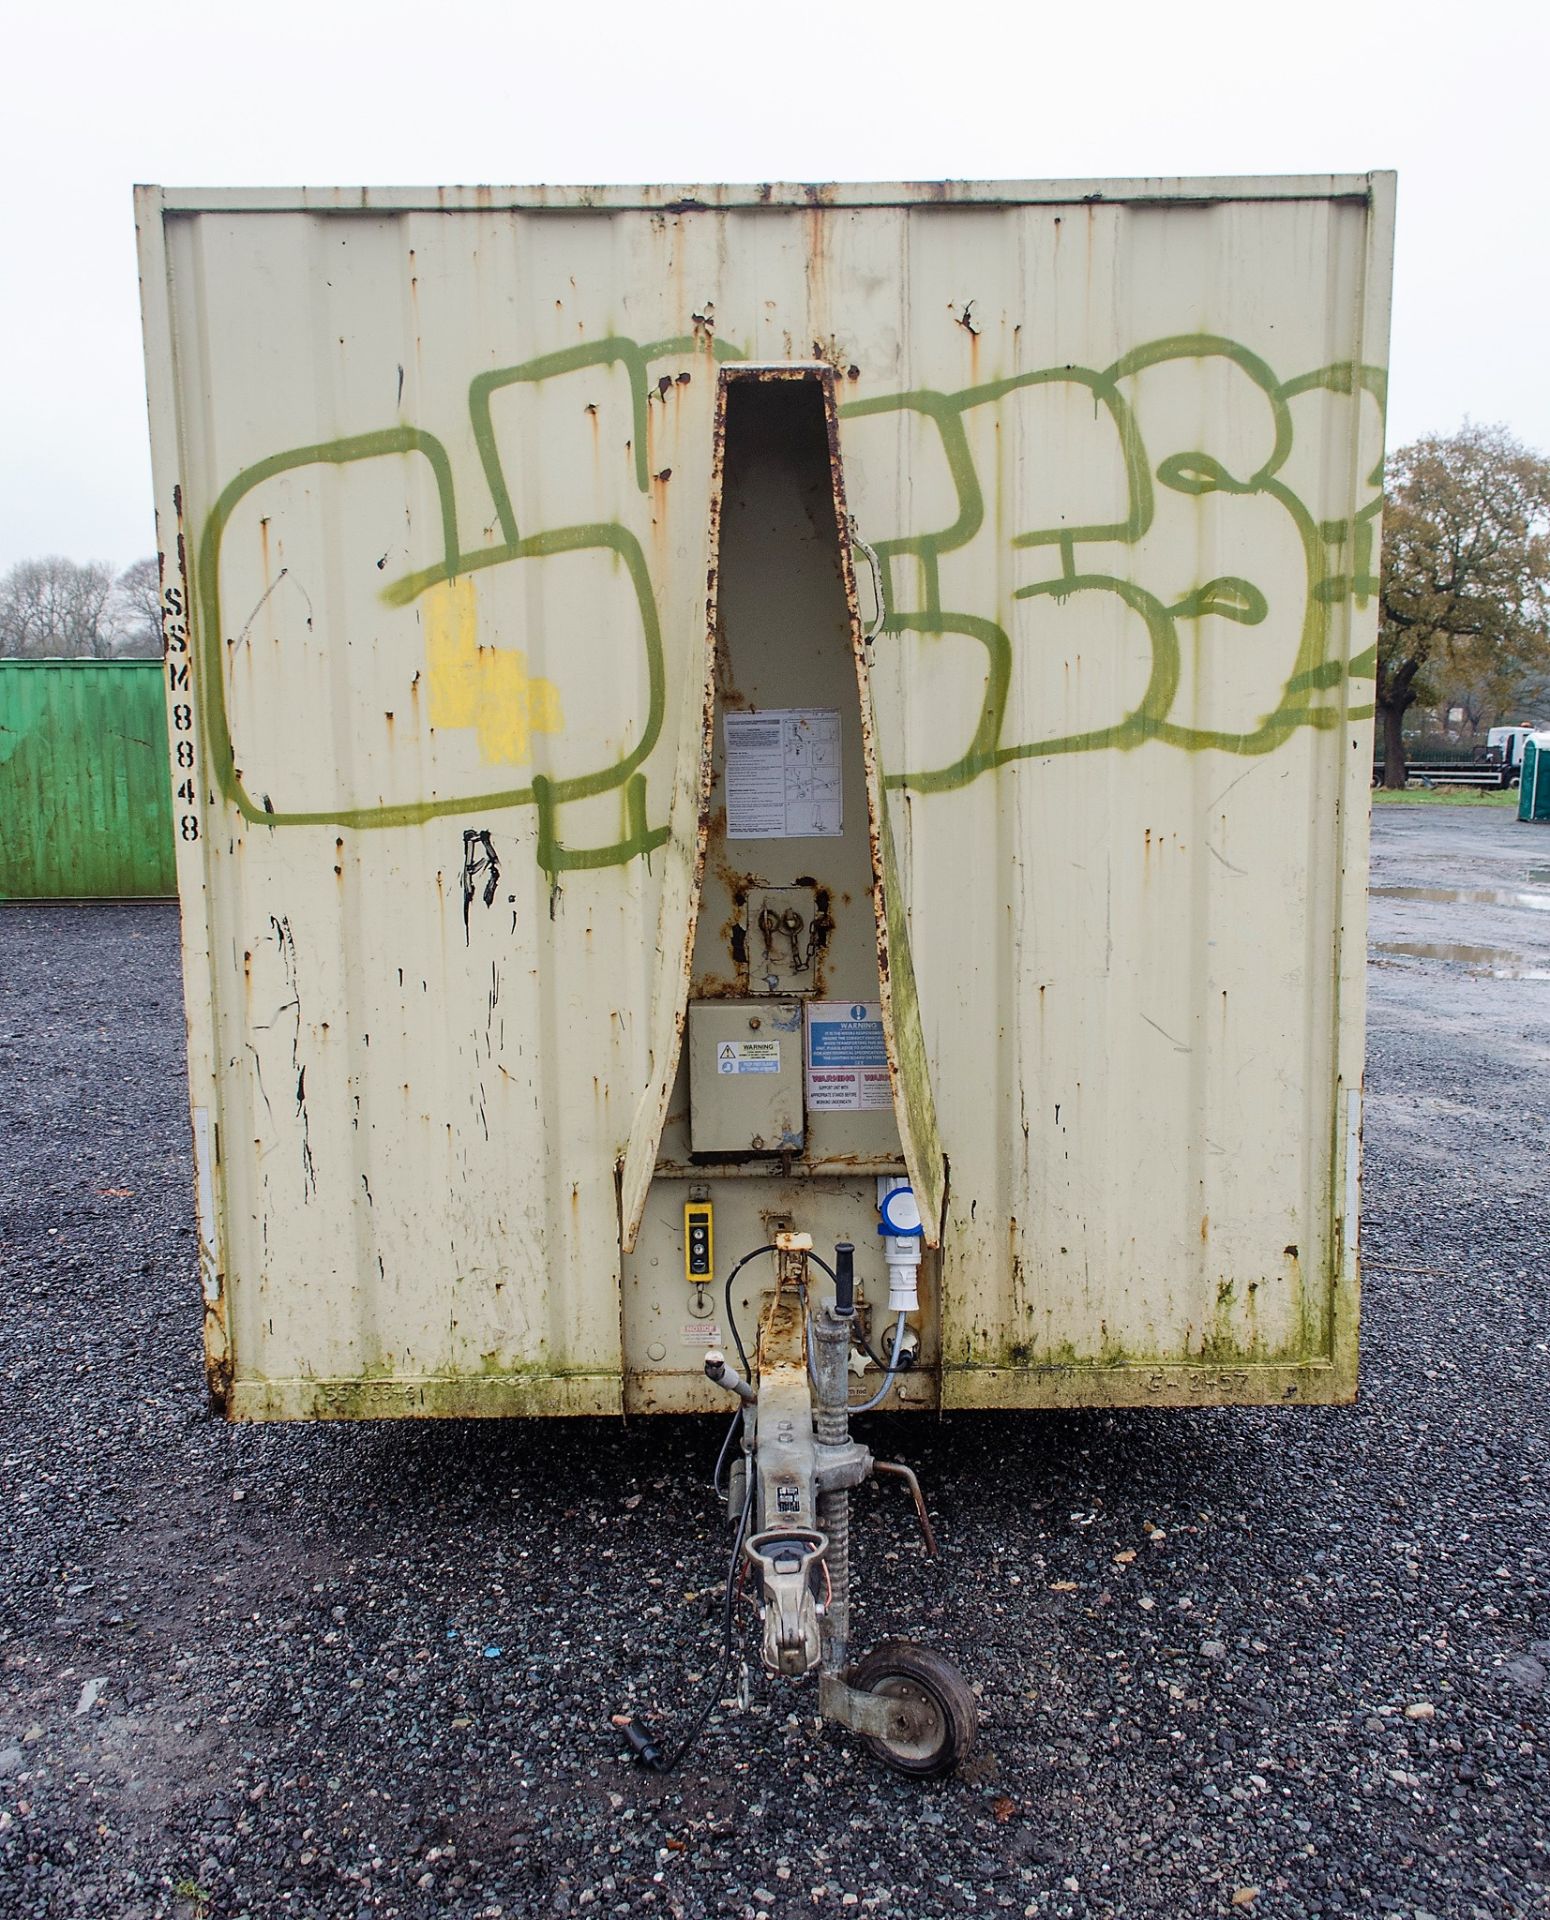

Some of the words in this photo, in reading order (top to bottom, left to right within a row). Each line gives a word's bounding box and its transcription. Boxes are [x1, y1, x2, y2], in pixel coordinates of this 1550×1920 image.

[743, 1043, 774, 1051] WARNING
[812, 1074, 856, 1082] WARNING
[864, 1074, 891, 1082] WARN
[686, 1324, 714, 1332] NOTICE
